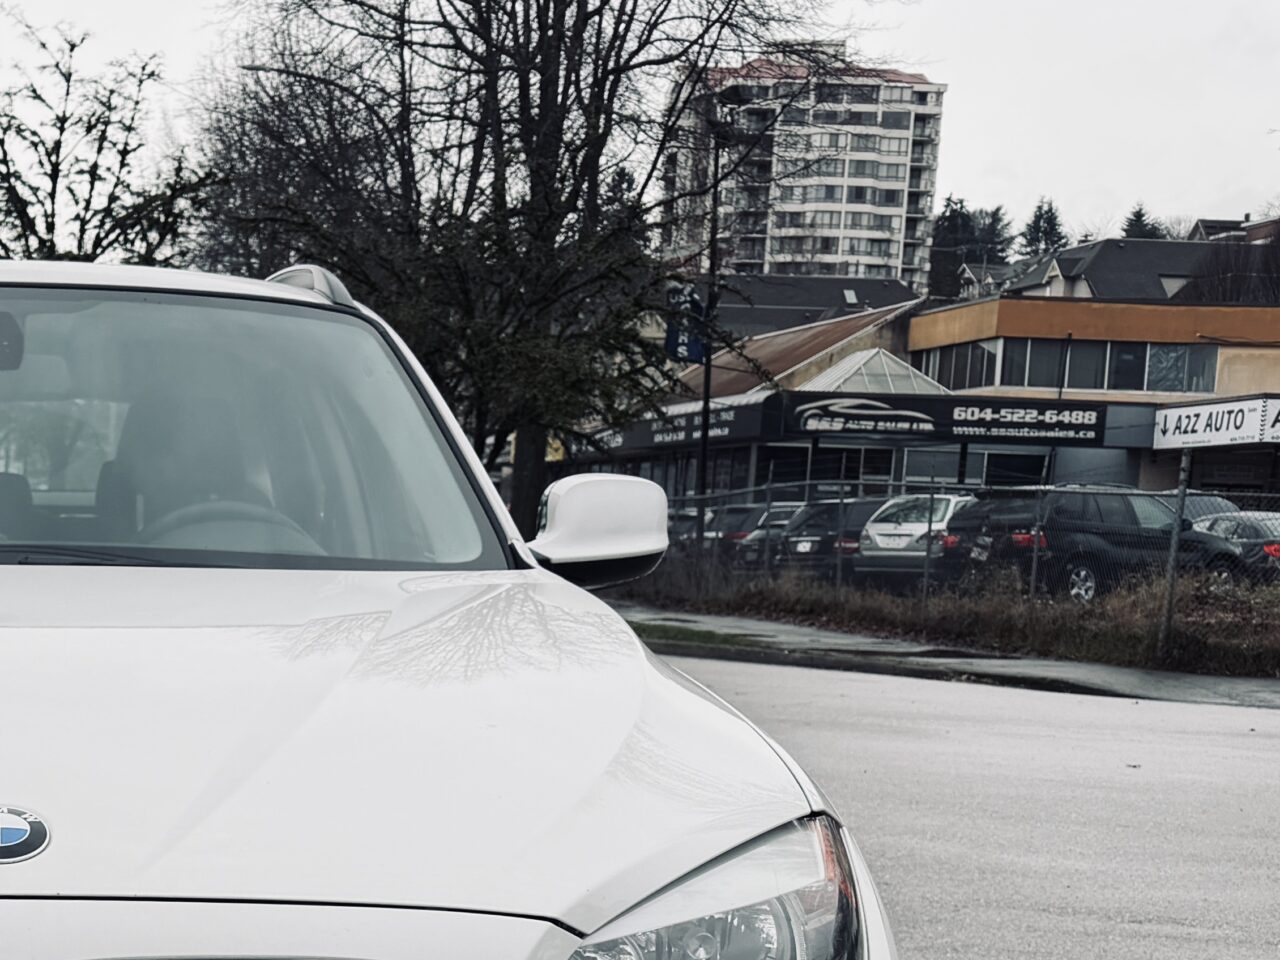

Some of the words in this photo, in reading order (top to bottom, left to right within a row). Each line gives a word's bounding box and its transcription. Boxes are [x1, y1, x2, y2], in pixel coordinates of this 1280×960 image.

[953, 406, 1097, 425] 604-522-6488
[1172, 413, 1201, 436] A2Z
[1203, 408, 1246, 433] AUTO
